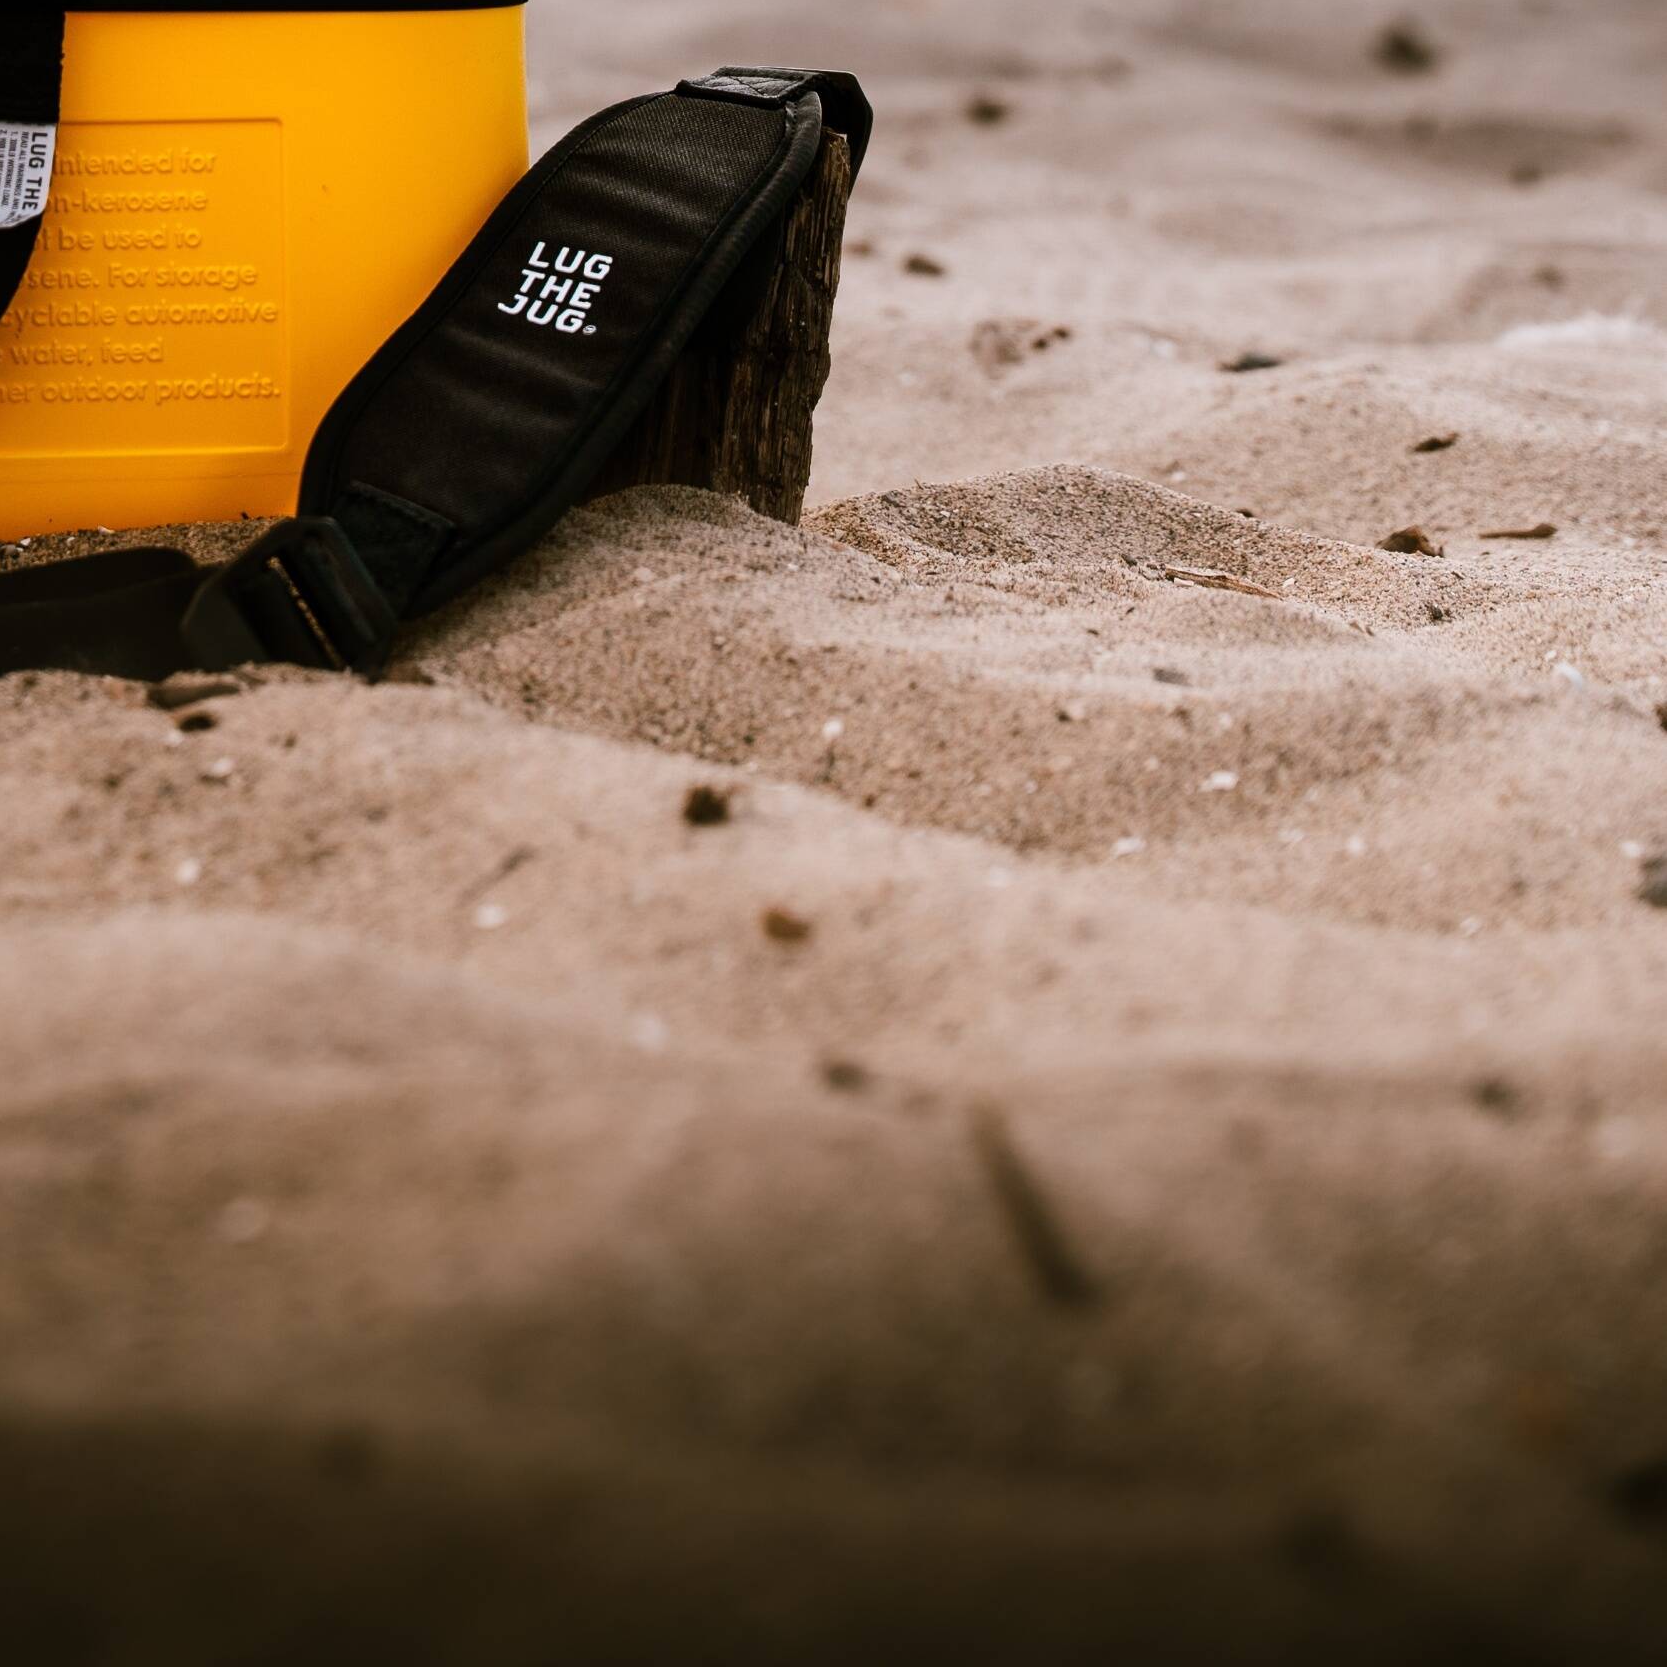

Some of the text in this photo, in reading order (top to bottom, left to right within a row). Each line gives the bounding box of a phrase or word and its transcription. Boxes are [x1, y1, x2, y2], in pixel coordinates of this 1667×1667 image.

[22, 132, 48, 210] LUG THE
[180, 147, 219, 175] for
[58, 226, 95, 251] be
[102, 223, 168, 250] used
[175, 222, 202, 249] to
[108, 263, 150, 288] For
[156, 260, 259, 292] storage
[528, 241, 613, 280] LUG
[519, 269, 601, 310] THE
[125, 297, 278, 325] automotive
[101, 336, 165, 364] feed
[40, 375, 149, 404] outdoor
[154, 371, 282, 405] products.
